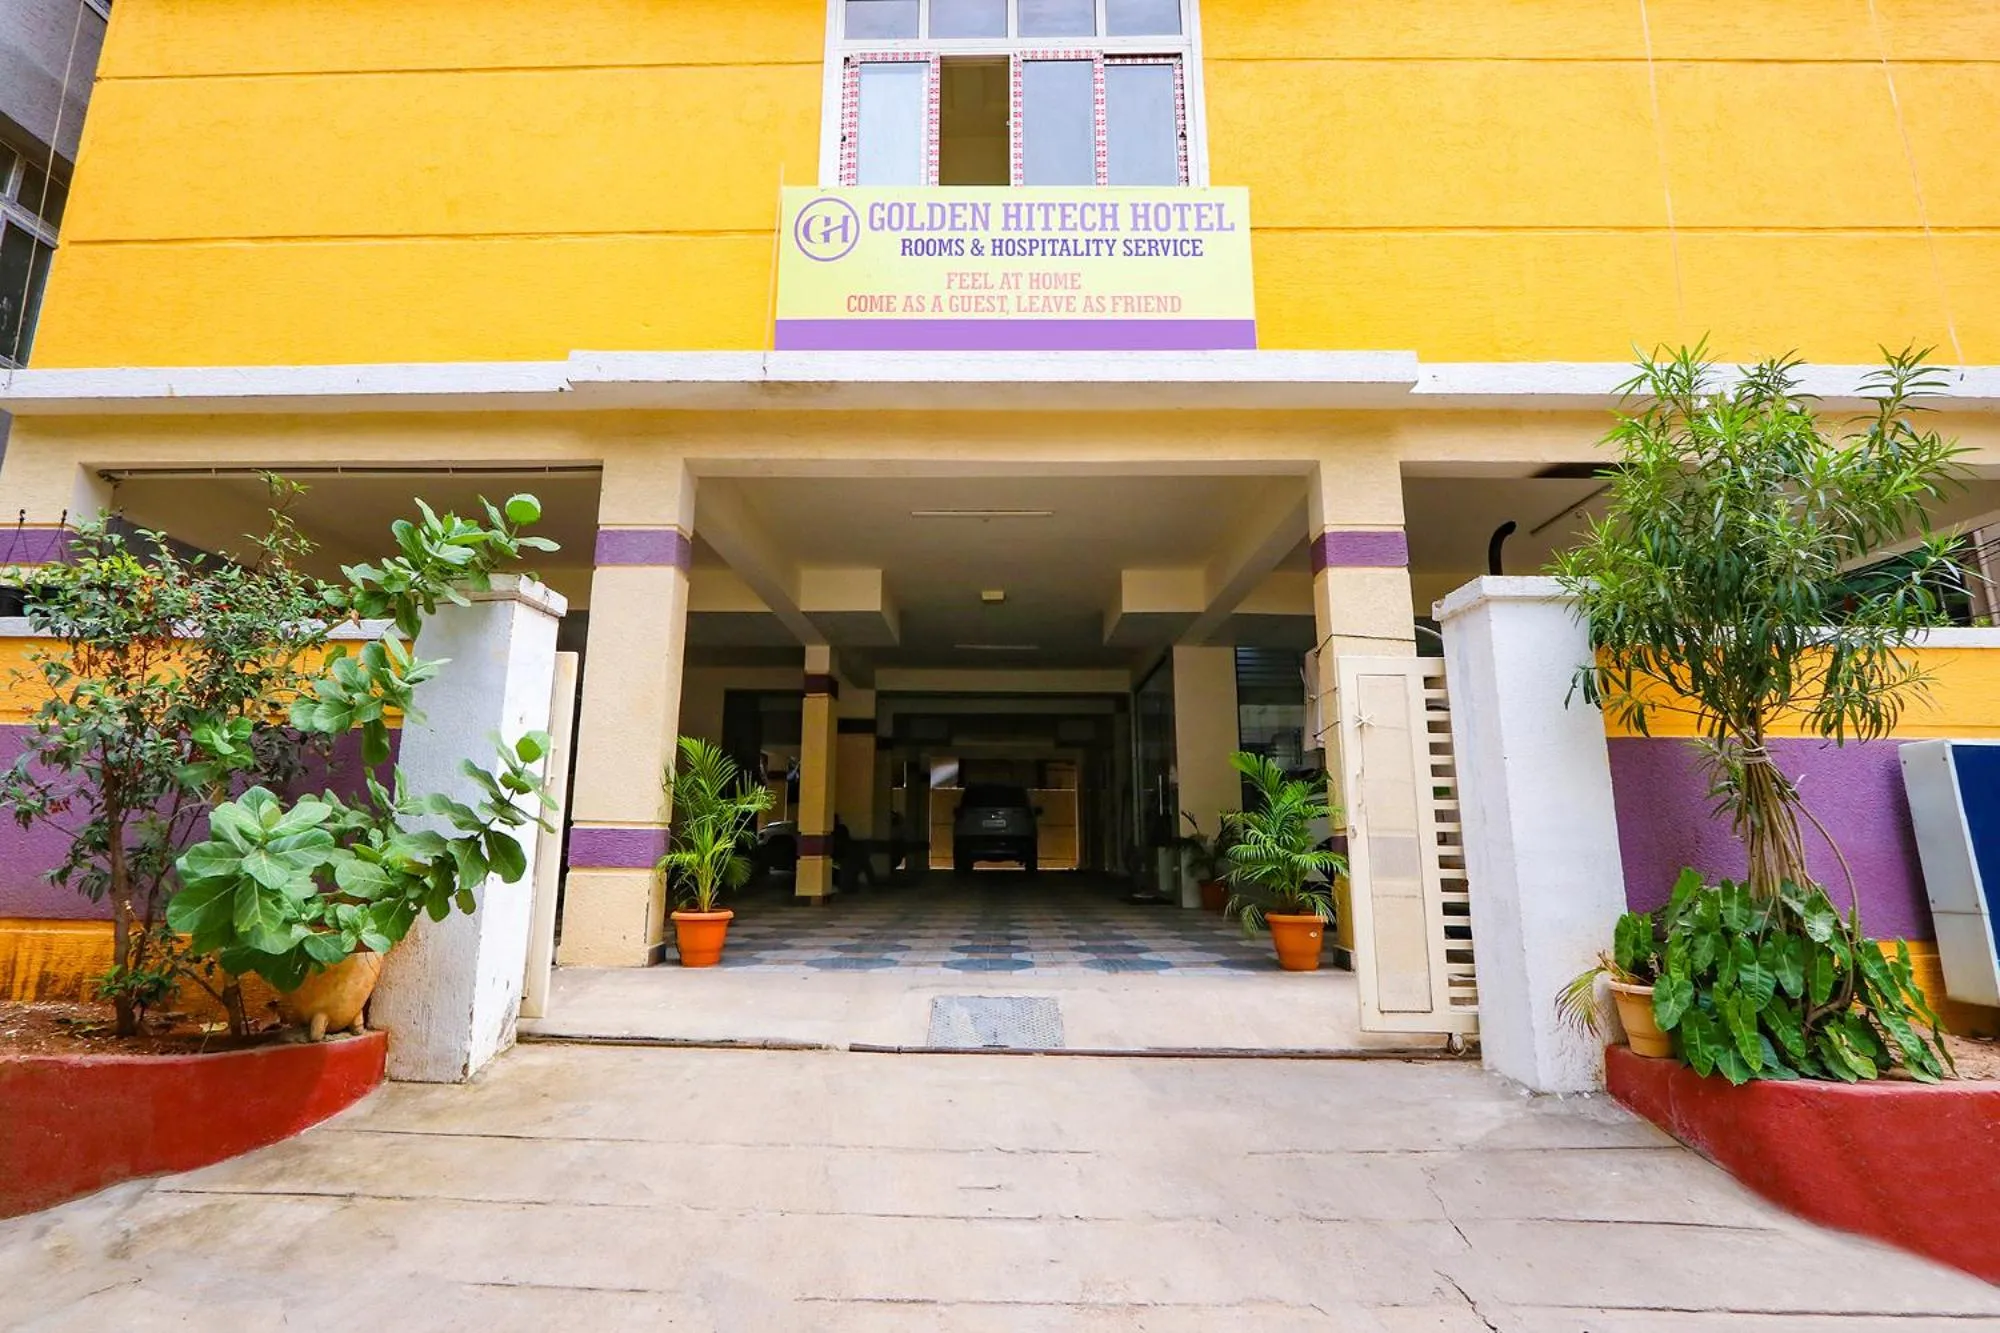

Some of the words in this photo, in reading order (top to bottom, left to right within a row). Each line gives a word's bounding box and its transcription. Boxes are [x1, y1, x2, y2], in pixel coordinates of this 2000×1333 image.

[868, 202, 991, 232] GOLDEN
[1001, 202, 1120, 232] HITECH
[1130, 202, 1236, 232] HOTEL
[900, 238, 965, 257] ROOMS
[970, 238, 985, 257] &
[991, 238, 1117, 257] HOSPITALITY
[1122, 238, 1204, 257] SERVICE
[946, 271, 995, 290] FEEL
[999, 271, 1024, 290] AT
[1028, 271, 1082, 290] HOME
[846, 295, 897, 313] COME
[902, 295, 926, 313] AS
[930, 295, 944, 313] A
[949, 295, 1010, 316] GUEST,
[1016, 295, 1077, 313] LEAVE
[1082, 295, 1107, 313] AS
[1111, 295, 1182, 314] FRIEND
